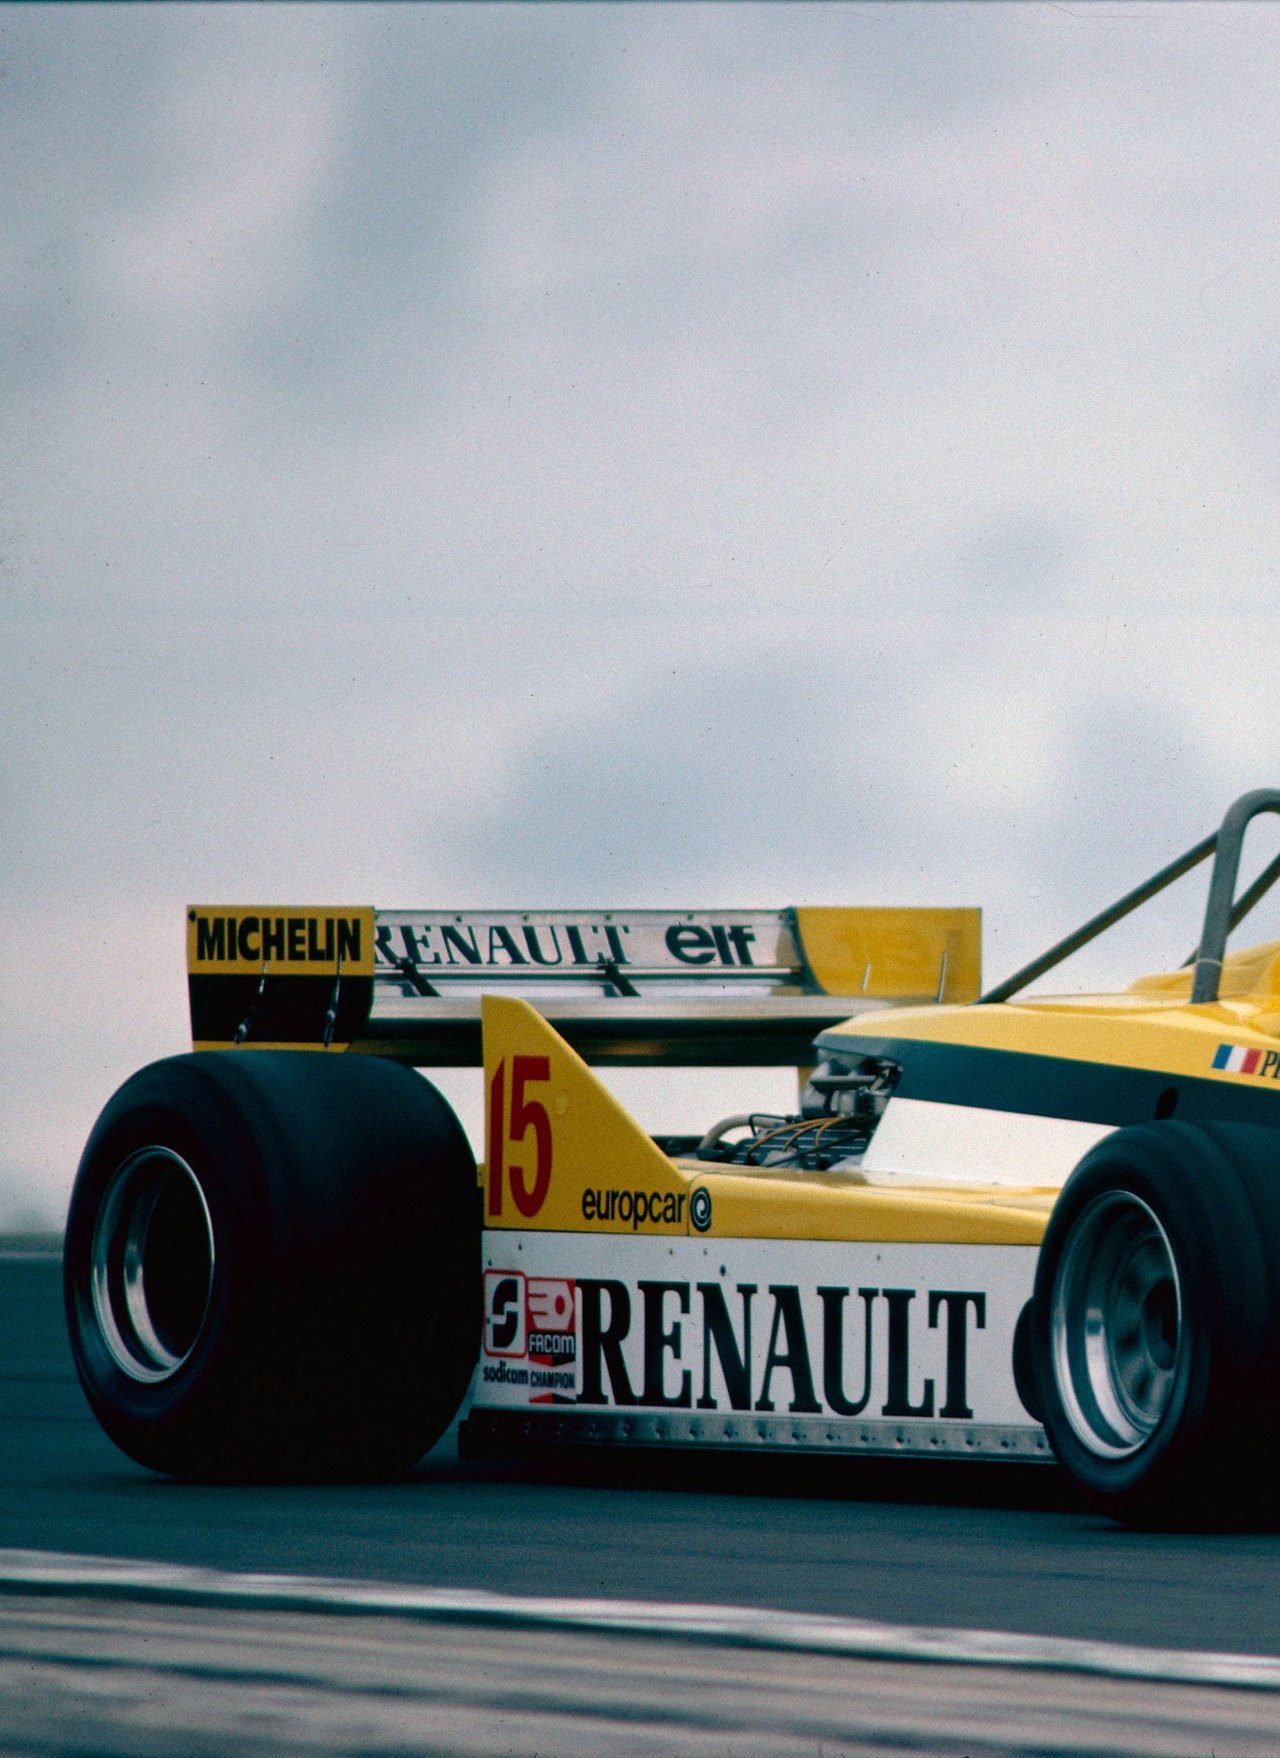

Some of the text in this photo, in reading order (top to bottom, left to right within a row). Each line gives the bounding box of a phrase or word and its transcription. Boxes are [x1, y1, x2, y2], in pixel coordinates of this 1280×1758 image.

[197, 917, 361, 961] MICHELIN
[373, 922, 757, 965] RENAULT elf
[488, 1055, 552, 1218] 15
[581, 1188, 684, 1230] europcar
[575, 1278, 987, 1419] RENAULT
[530, 1371, 575, 1389] CHAMPION
